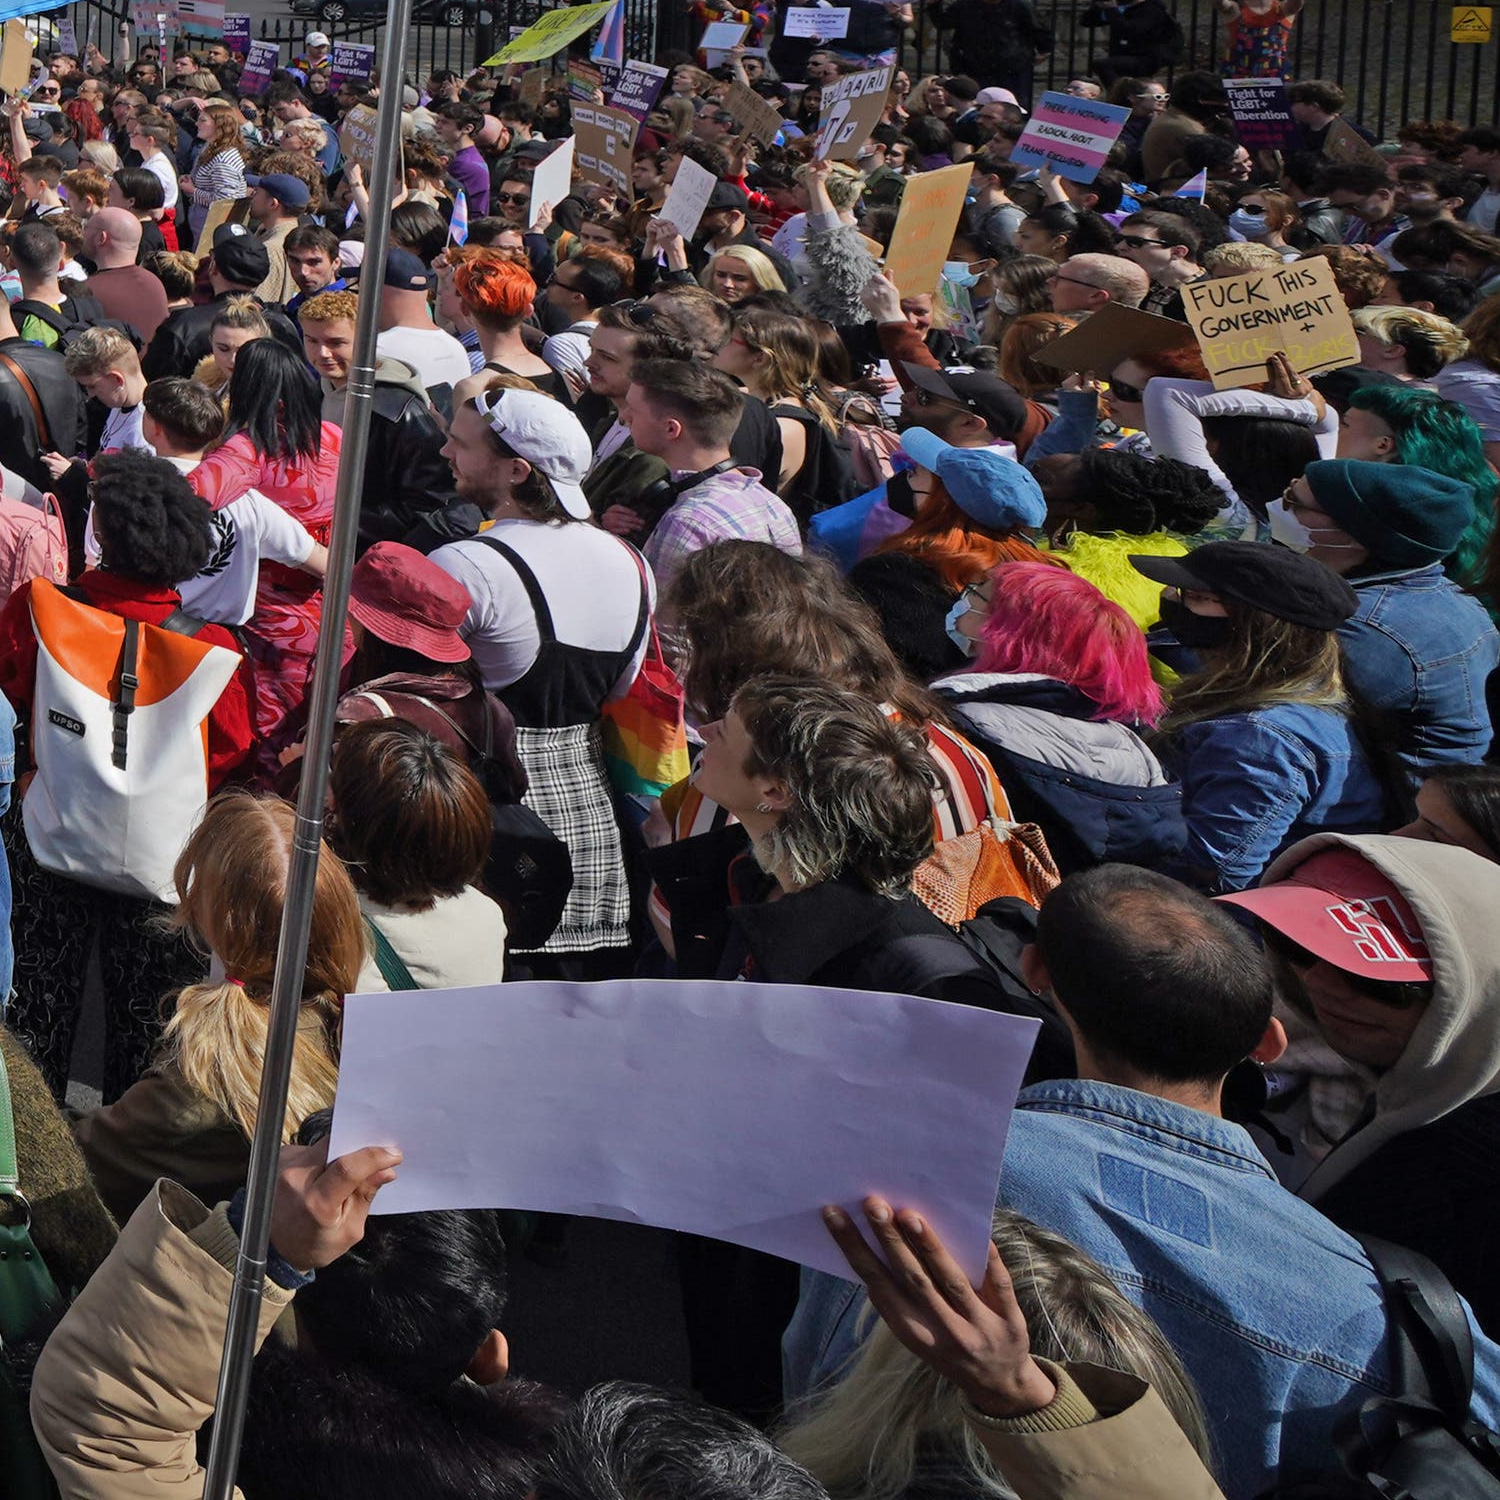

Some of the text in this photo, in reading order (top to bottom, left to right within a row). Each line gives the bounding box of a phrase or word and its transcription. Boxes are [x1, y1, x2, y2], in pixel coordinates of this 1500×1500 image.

[250, 47, 273, 59] Fight for
[334, 49, 368, 60] Fight for
[334, 57, 359, 66] LGBT+
[333, 65, 368, 77] liberation
[621, 70, 644, 84] Fight
[644, 75, 656, 87] for
[616, 80, 643, 95] LGBT+
[1227, 88, 1276, 99] Fight for
[611, 91, 649, 111] liberation
[1230, 100, 1268, 110] LGBT+
[1043, 101, 1067, 113] THERE
[1076, 108, 1111, 124] NOTHING
[1233, 110, 1289, 120] liberation
[1037, 124, 1094, 145] RADICAL ABOUT
[1021, 143, 1087, 169] TRANS EXCLUSION
[1189, 269, 1317, 311] FUCK THIS
[1200, 294, 1333, 338] GOVERNMENT
[1207, 336, 1277, 368] FUCK
[53, 714, 80, 731] UPSO
